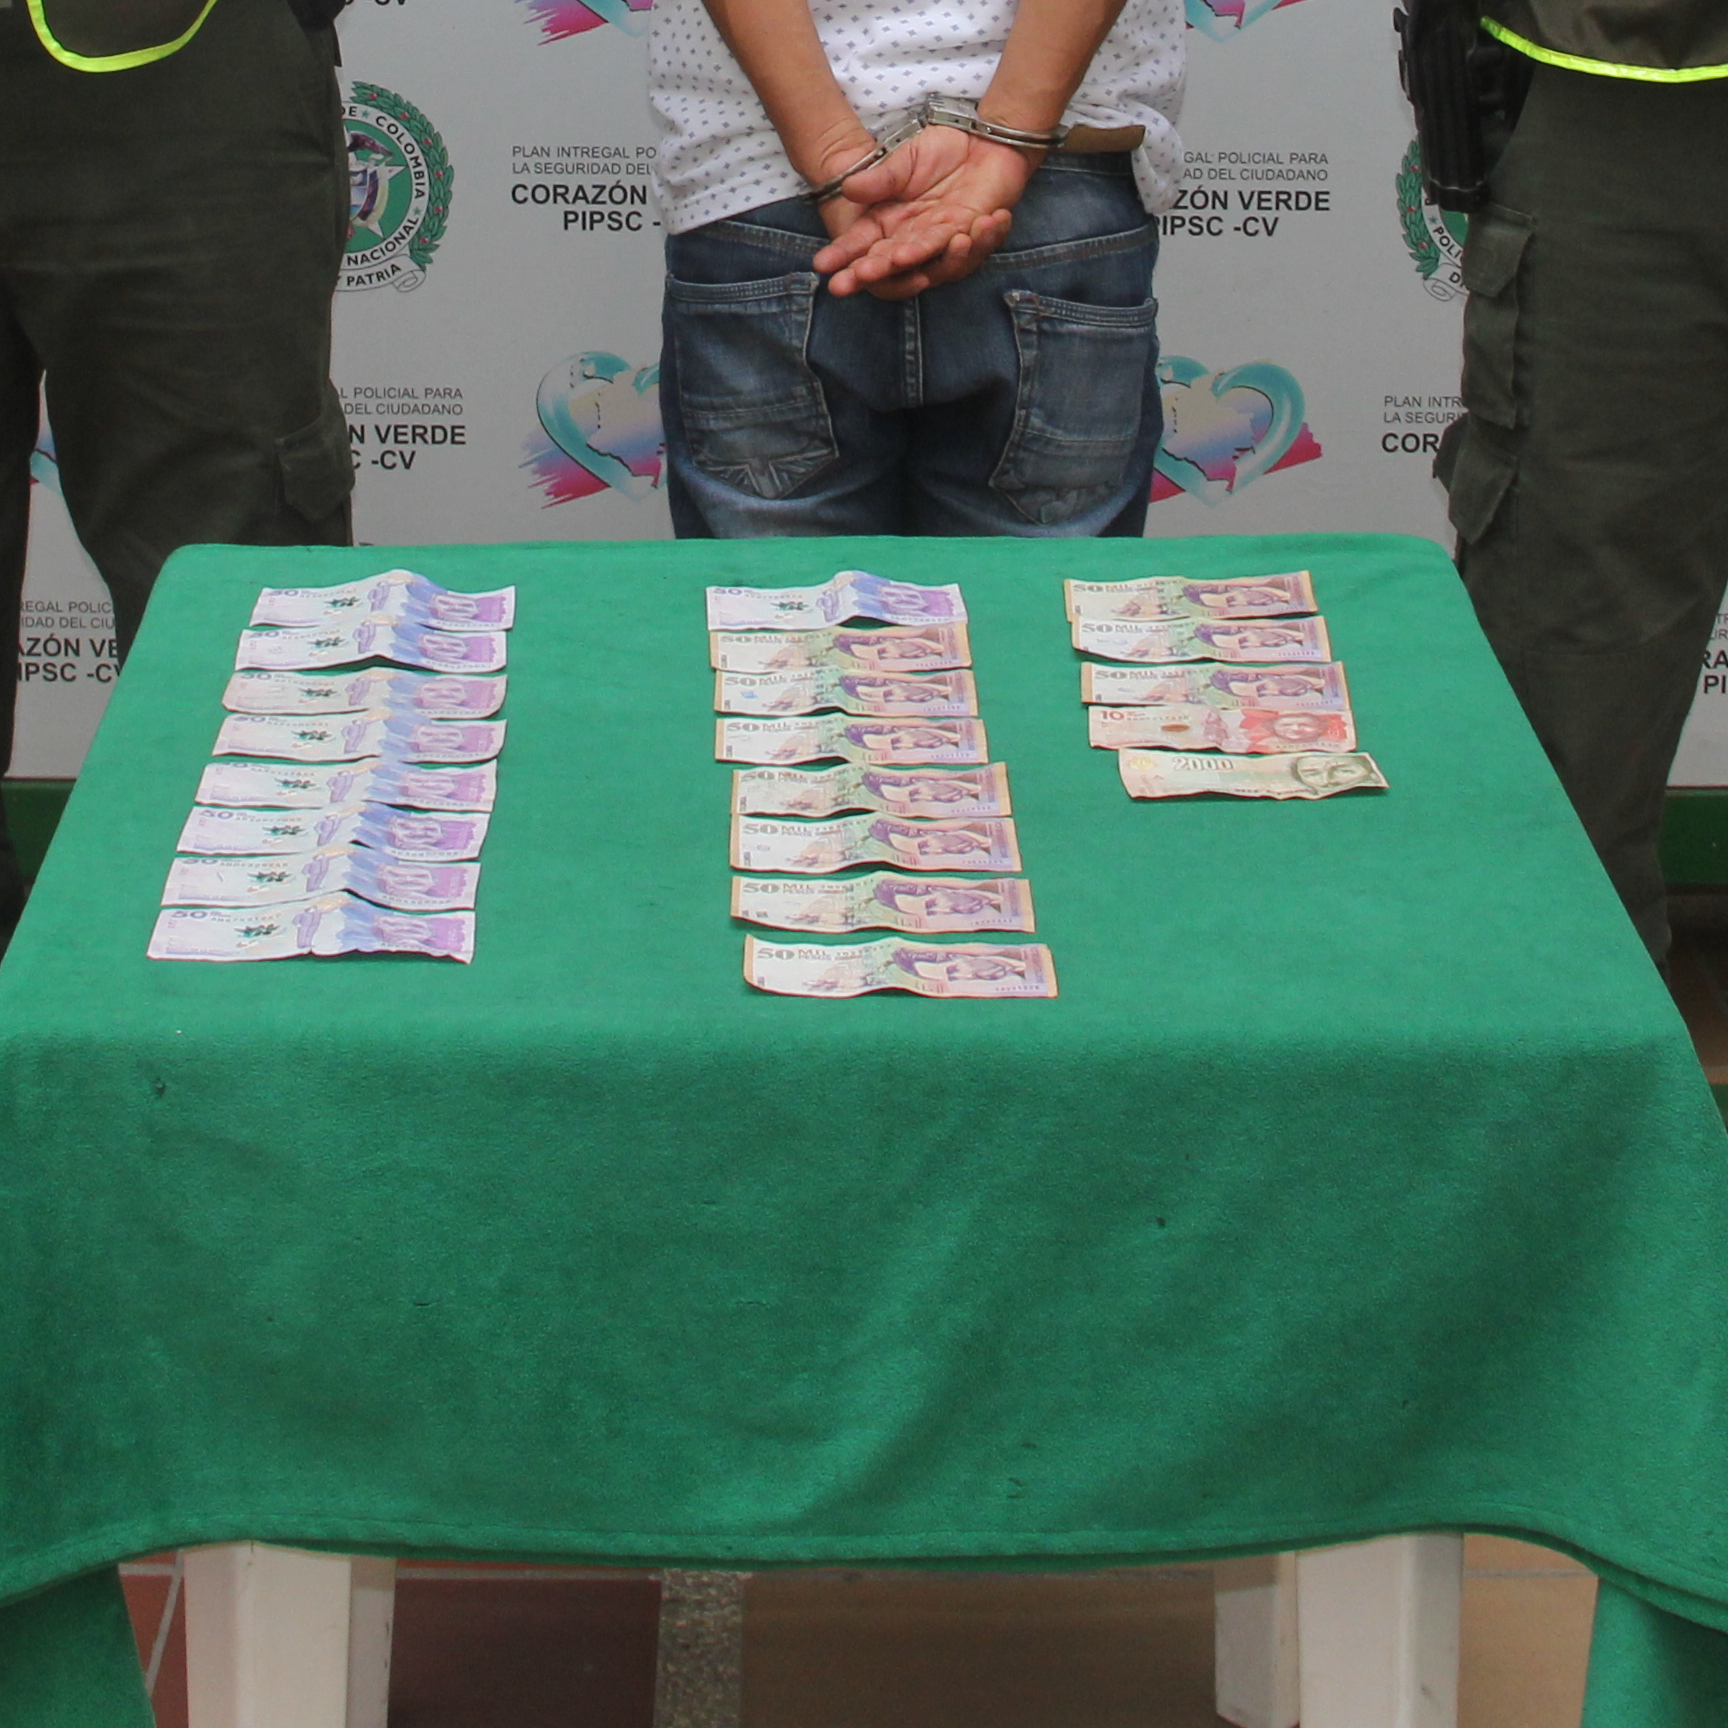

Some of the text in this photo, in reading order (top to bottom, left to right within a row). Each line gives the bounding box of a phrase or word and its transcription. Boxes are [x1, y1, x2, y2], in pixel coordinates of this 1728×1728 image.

[1081, 623, 1113, 633] 50
[1100, 710, 1123, 721] 10
[726, 721, 760, 731] 50
[1173, 756, 1234, 771] 2000
[743, 823, 779, 835] 50
[742, 882, 780, 894] 50
[756, 948, 827, 960] 50 MIL
